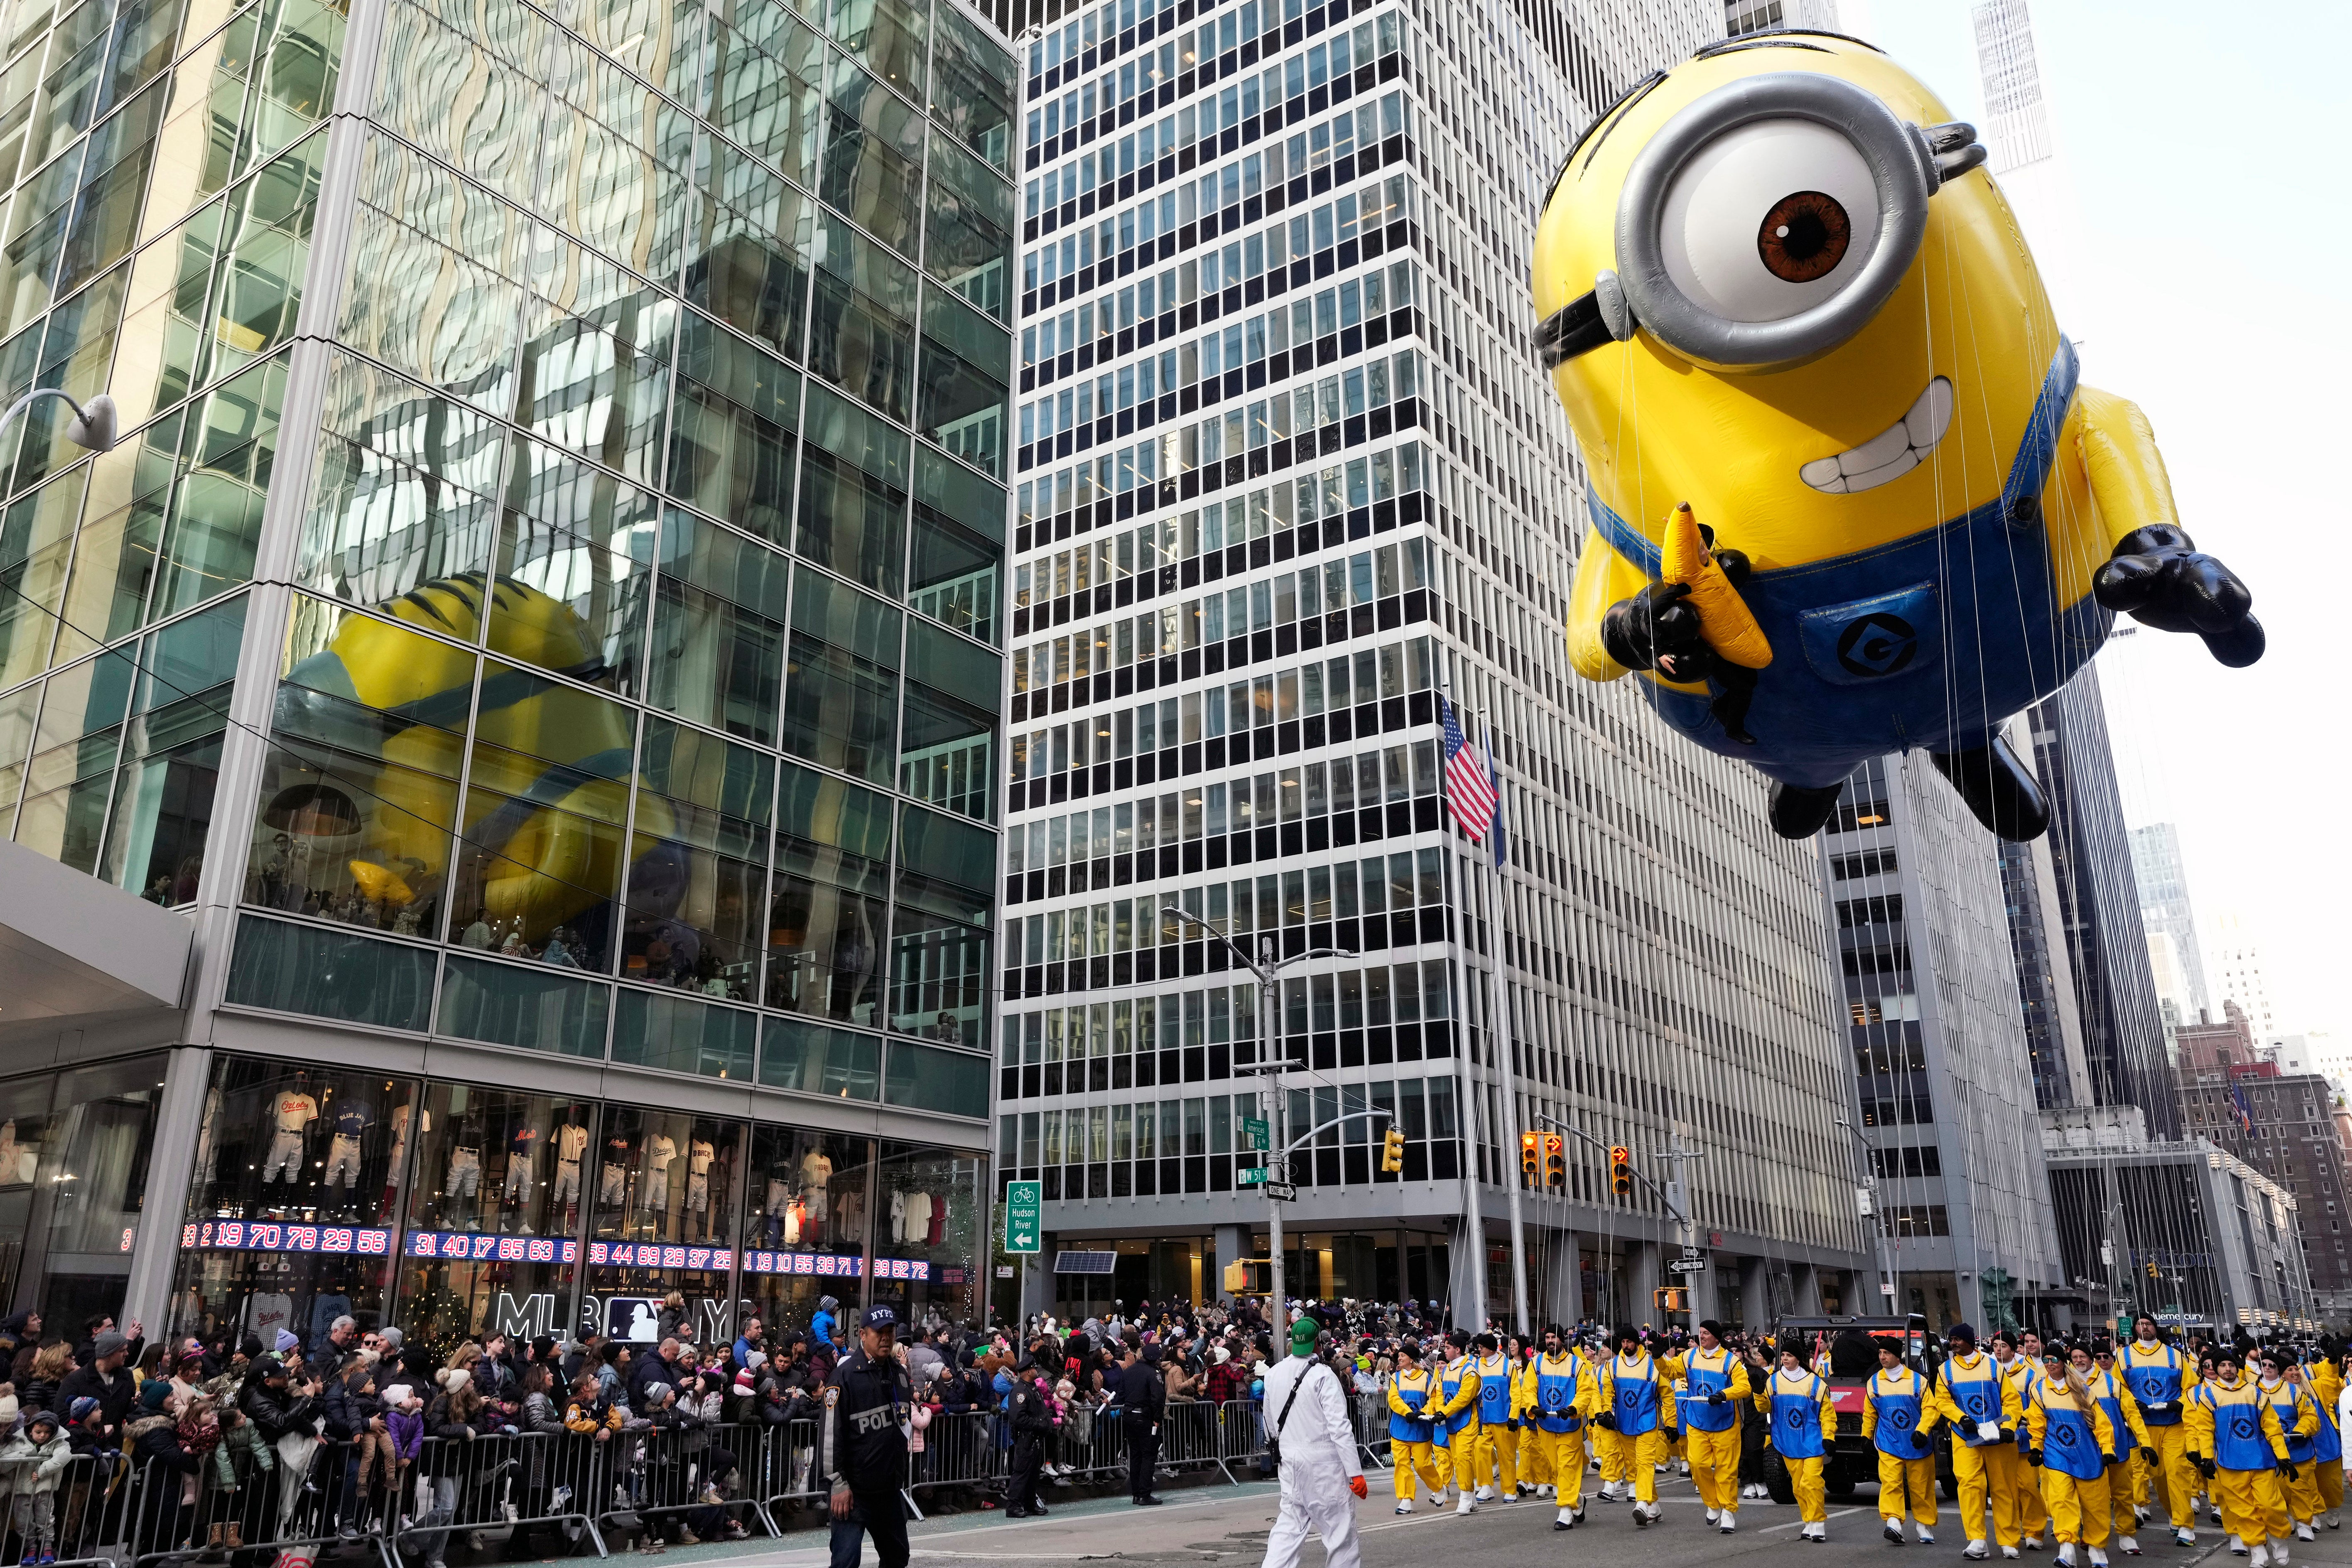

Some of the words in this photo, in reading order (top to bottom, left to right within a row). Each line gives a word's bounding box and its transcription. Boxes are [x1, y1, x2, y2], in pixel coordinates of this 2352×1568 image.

[339, 1112, 354, 1121] BLUE
[1248, 1124, 1265, 1134] Americas
[1257, 1137, 1261, 1147] 6
[1247, 1169, 1252, 1181] W
[1254, 1170, 1261, 1181] 51
[1012, 1208, 1035, 1217] Hudson
[1015, 1220, 1032, 1229] River
[121, 1228, 132, 1251] 3
[200, 1223, 212, 1247] 2
[216, 1222, 243, 1247] 19
[249, 1224, 280, 1248] 70
[286, 1226, 317, 1250] 78
[321, 1228, 352, 1251] 29
[357, 1230, 387, 1253] 56
[415, 1234, 437, 1256] 31
[442, 1235, 469, 1257] 40
[473, 1237, 495, 1258] 17
[499, 1238, 525, 1260] 85
[529, 1240, 554, 1261] 63
[612, 1244, 633, 1265] 44
[638, 1246, 660, 1266] 89
[664, 1247, 685, 1267] 28
[689, 1249, 710, 1268] 37
[713, 1250, 731, 1269] 25
[757, 1253, 773, 1271] 19
[776, 1254, 792, 1272] 10
[795, 1255, 814, 1273] 55
[817, 1256, 835, 1274] 38
[838, 1257, 851, 1275] 71
[893, 1261, 909, 1278] 52
[912, 1261, 928, 1278] 72
[2129, 1247, 2215, 1267] Hilton
[871, 1309, 893, 1321] NYPD
[2147, 1311, 2204, 1322] luemecury
